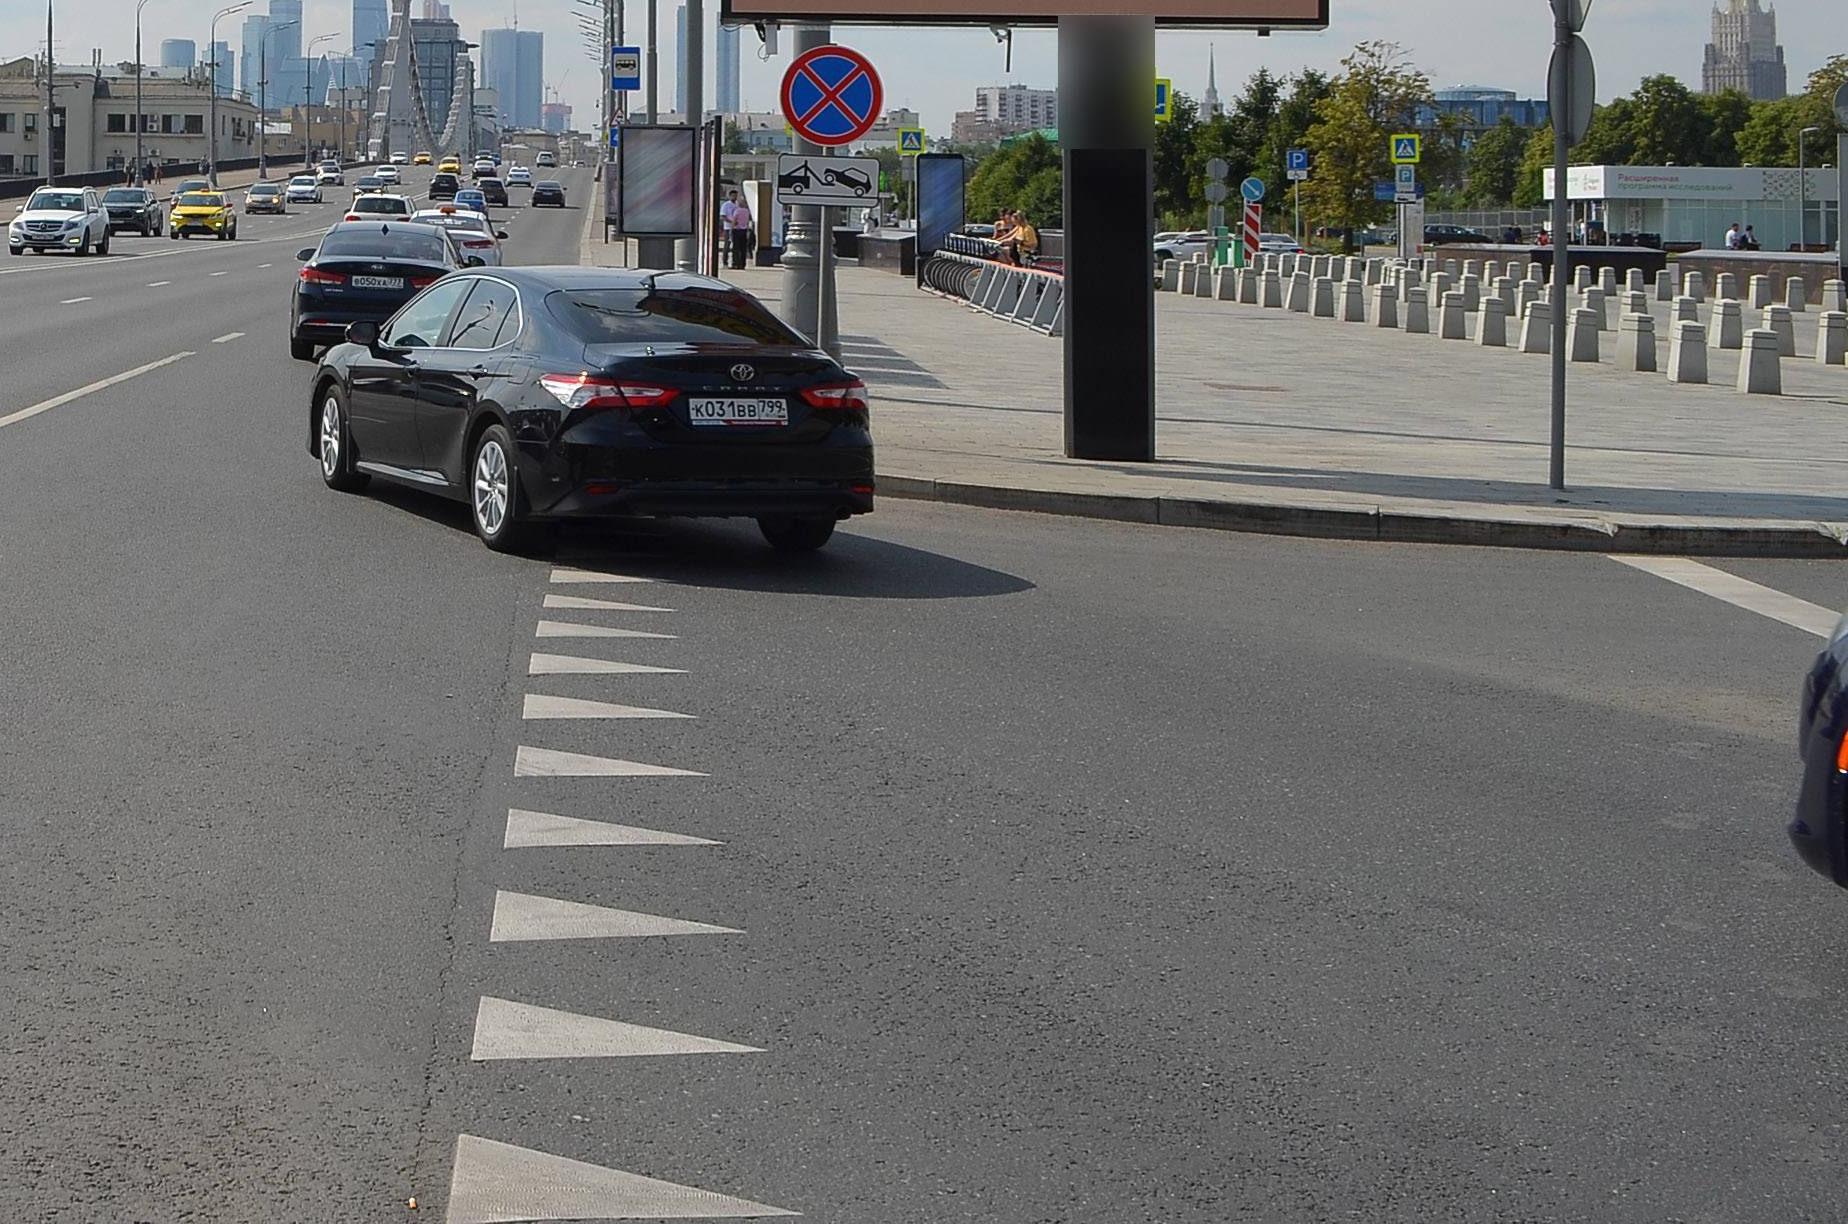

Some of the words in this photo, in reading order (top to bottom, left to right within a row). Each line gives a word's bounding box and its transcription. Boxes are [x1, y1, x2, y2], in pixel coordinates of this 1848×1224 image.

[1617, 172, 1680, 183] Расширенная
[1617, 182, 1668, 191] программа
[1669, 183, 1733, 192] исследований
[694, 400, 757, 417] К031ВВ
[758, 400, 783, 413] 799
